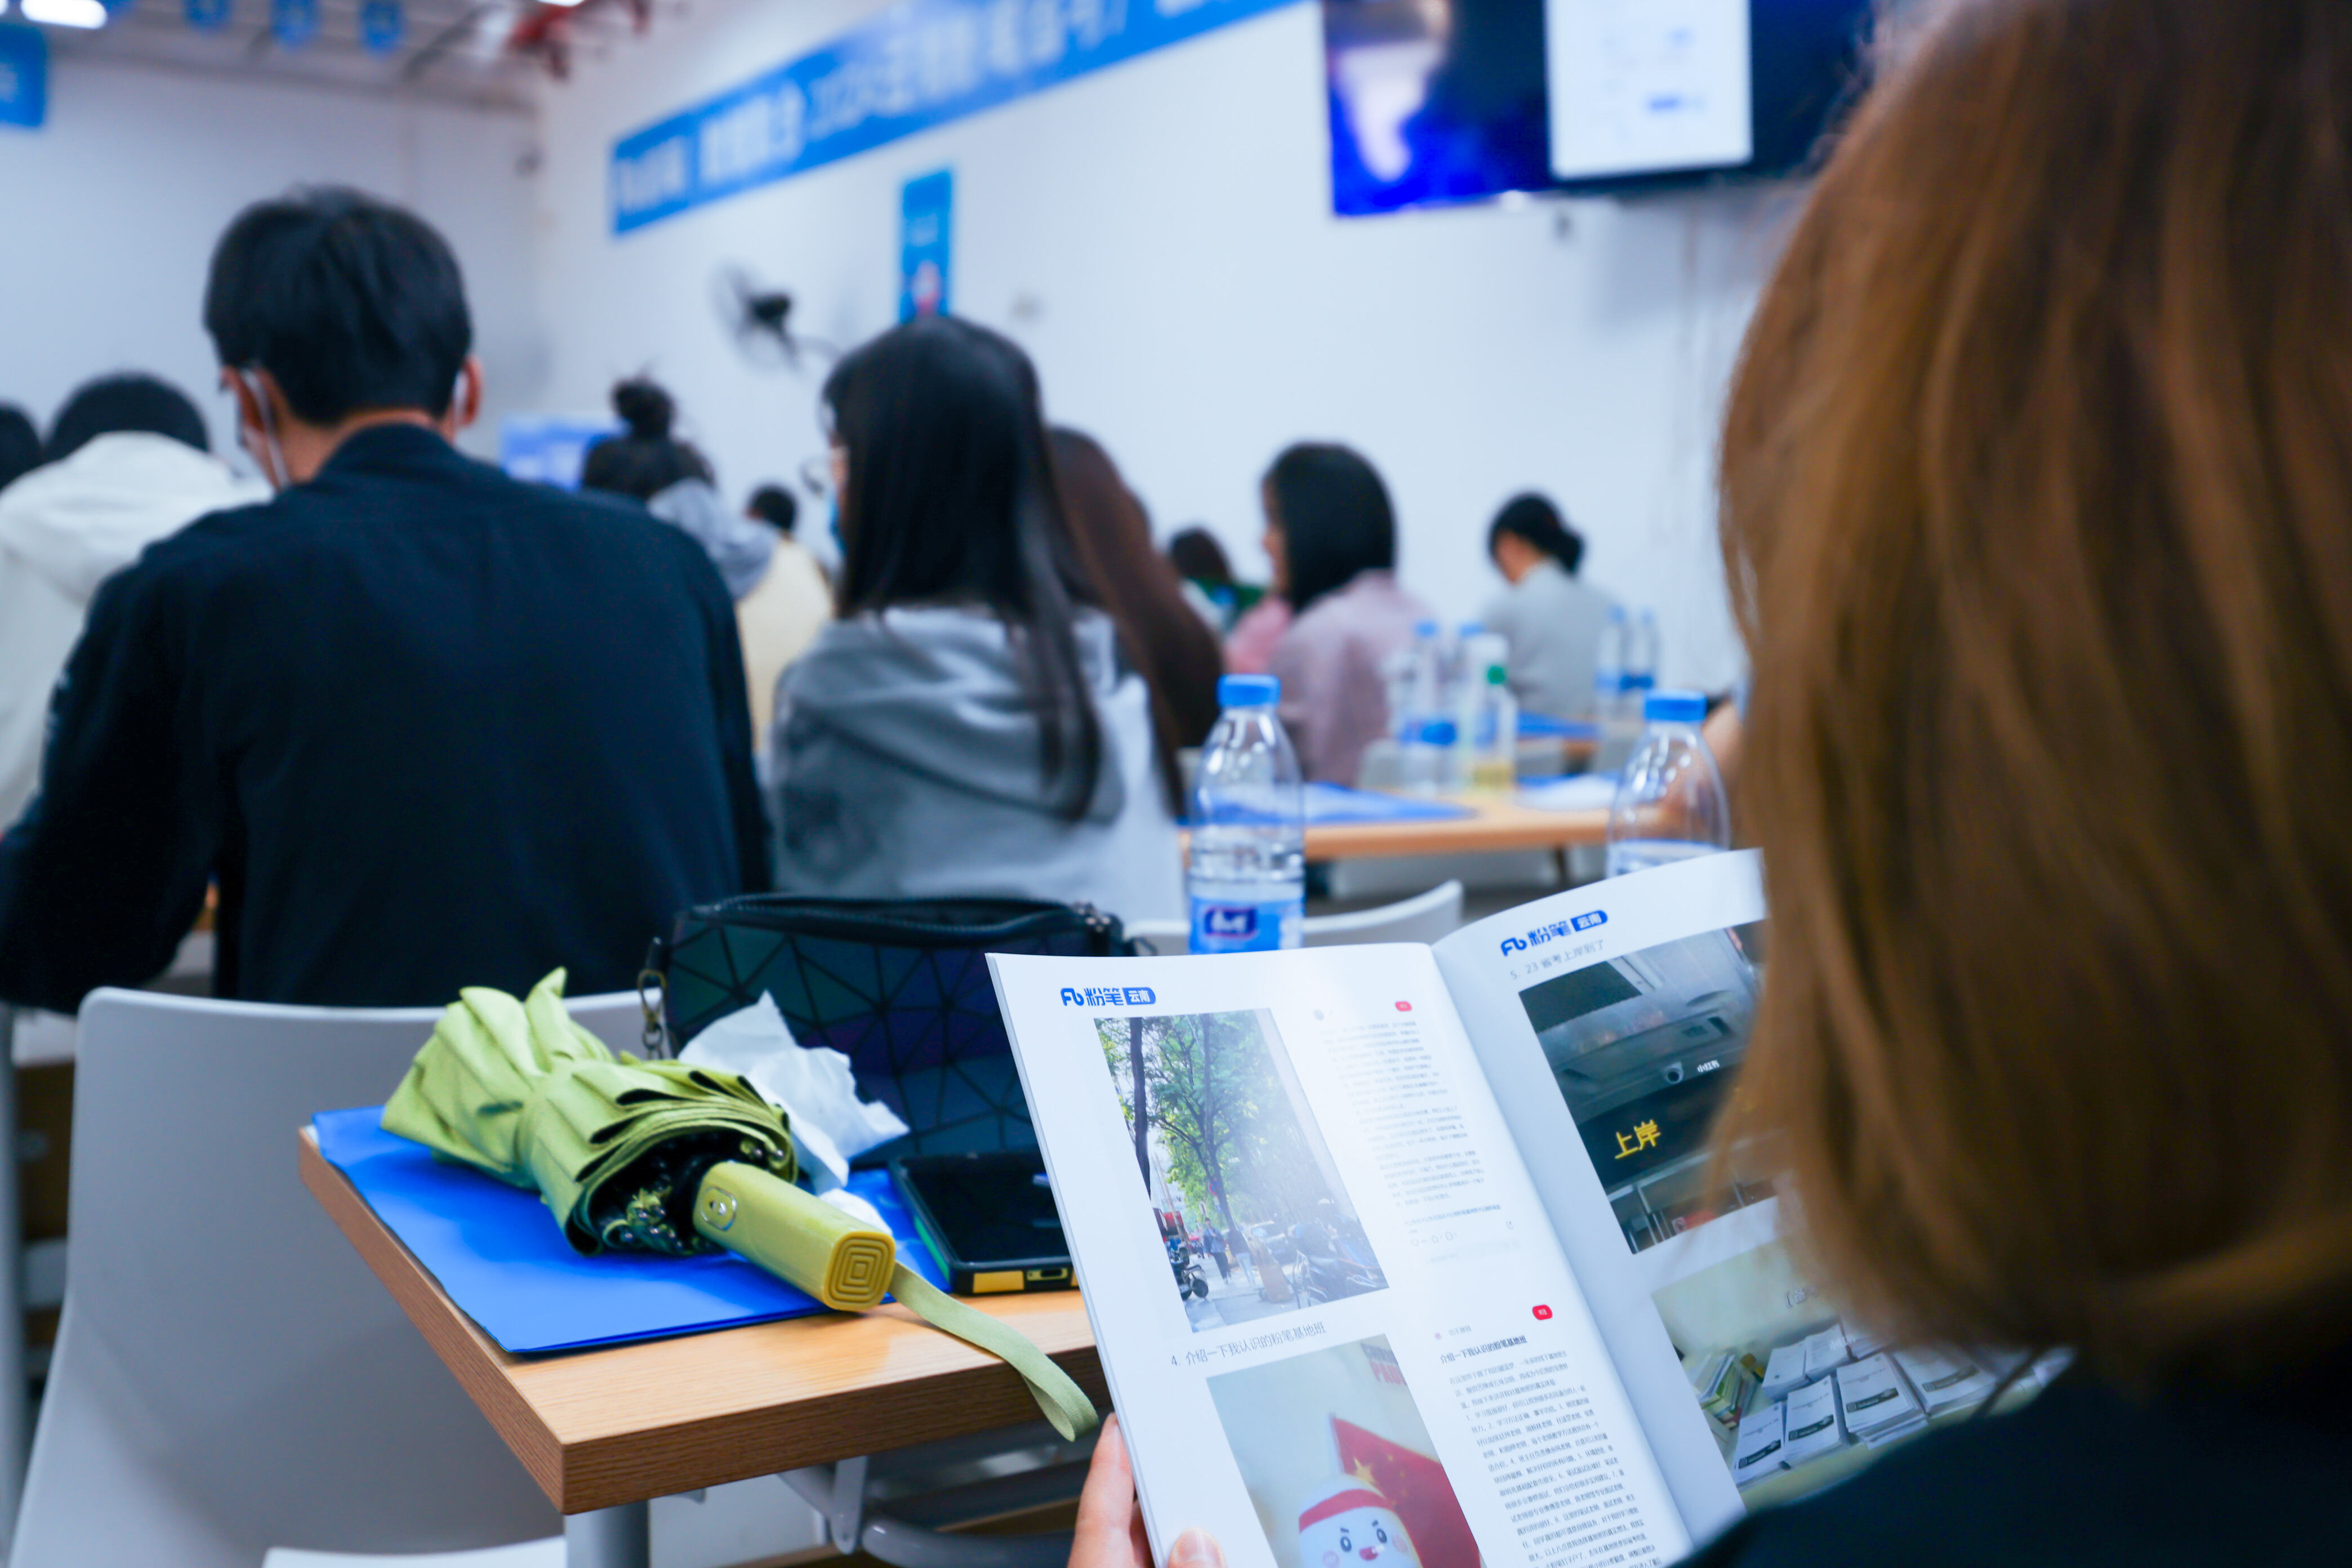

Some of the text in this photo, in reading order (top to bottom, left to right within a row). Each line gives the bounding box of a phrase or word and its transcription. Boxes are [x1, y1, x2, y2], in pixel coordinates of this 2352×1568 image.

[1527, 920, 1572, 947] 粉笔
[1576, 912, 1602, 929] 云南
[1084, 987, 1124, 1006] 粉笔
[1128, 989, 1151, 1003] 云南
[1615, 1119, 1661, 1160] 上岸
[1185, 1321, 1327, 1365] 介绍一下我认识的粉笔基地班
